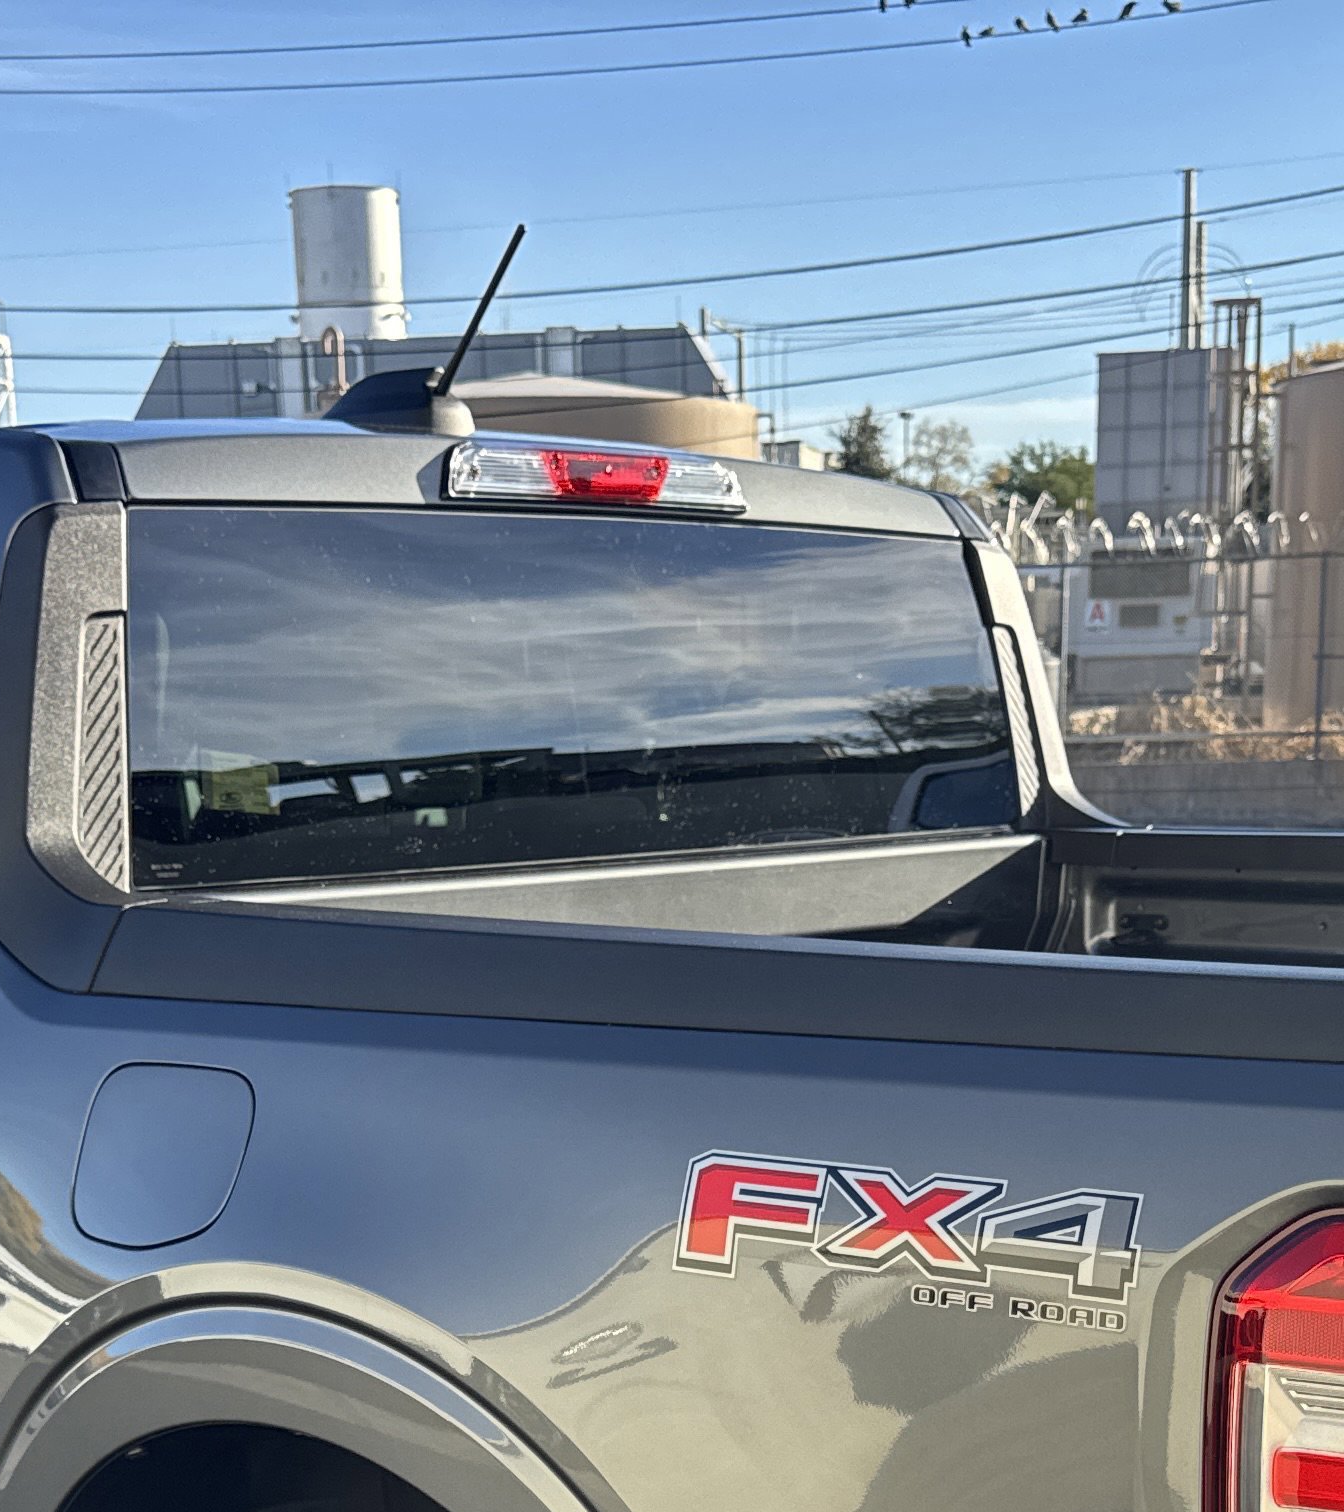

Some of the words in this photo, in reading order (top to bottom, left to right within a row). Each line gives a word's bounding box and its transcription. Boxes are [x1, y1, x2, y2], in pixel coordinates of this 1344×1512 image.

[672, 1149, 1144, 1305] FX4
[911, 1284, 994, 1312] OFF
[1009, 1297, 1126, 1333] ROAD
